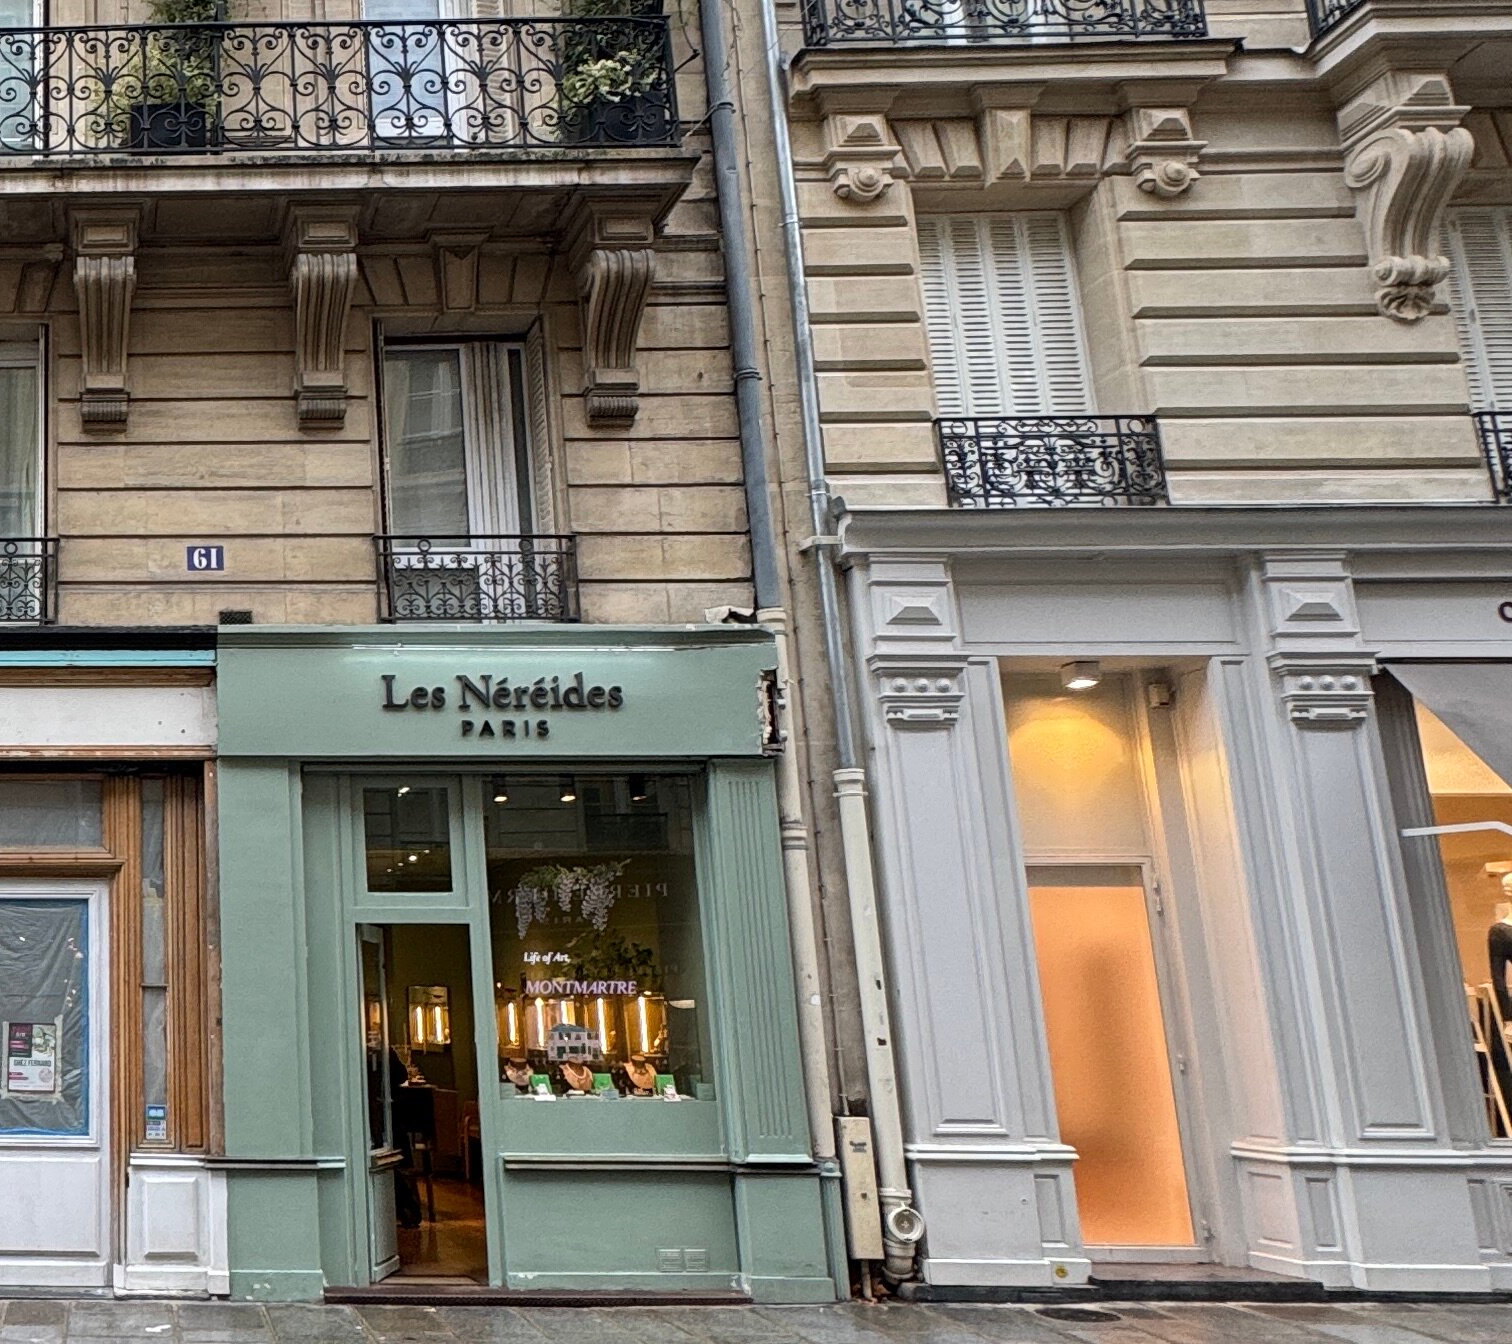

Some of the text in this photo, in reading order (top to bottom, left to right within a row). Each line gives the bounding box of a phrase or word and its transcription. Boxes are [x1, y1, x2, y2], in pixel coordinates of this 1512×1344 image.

[192, 547, 218, 570] 61
[381, 671, 624, 709] Les Néréides
[461, 719, 550, 737] PARIS
[523, 951, 541, 965] Life
[542, 951, 554, 965] of
[525, 980, 637, 994] MONTMARTRE
